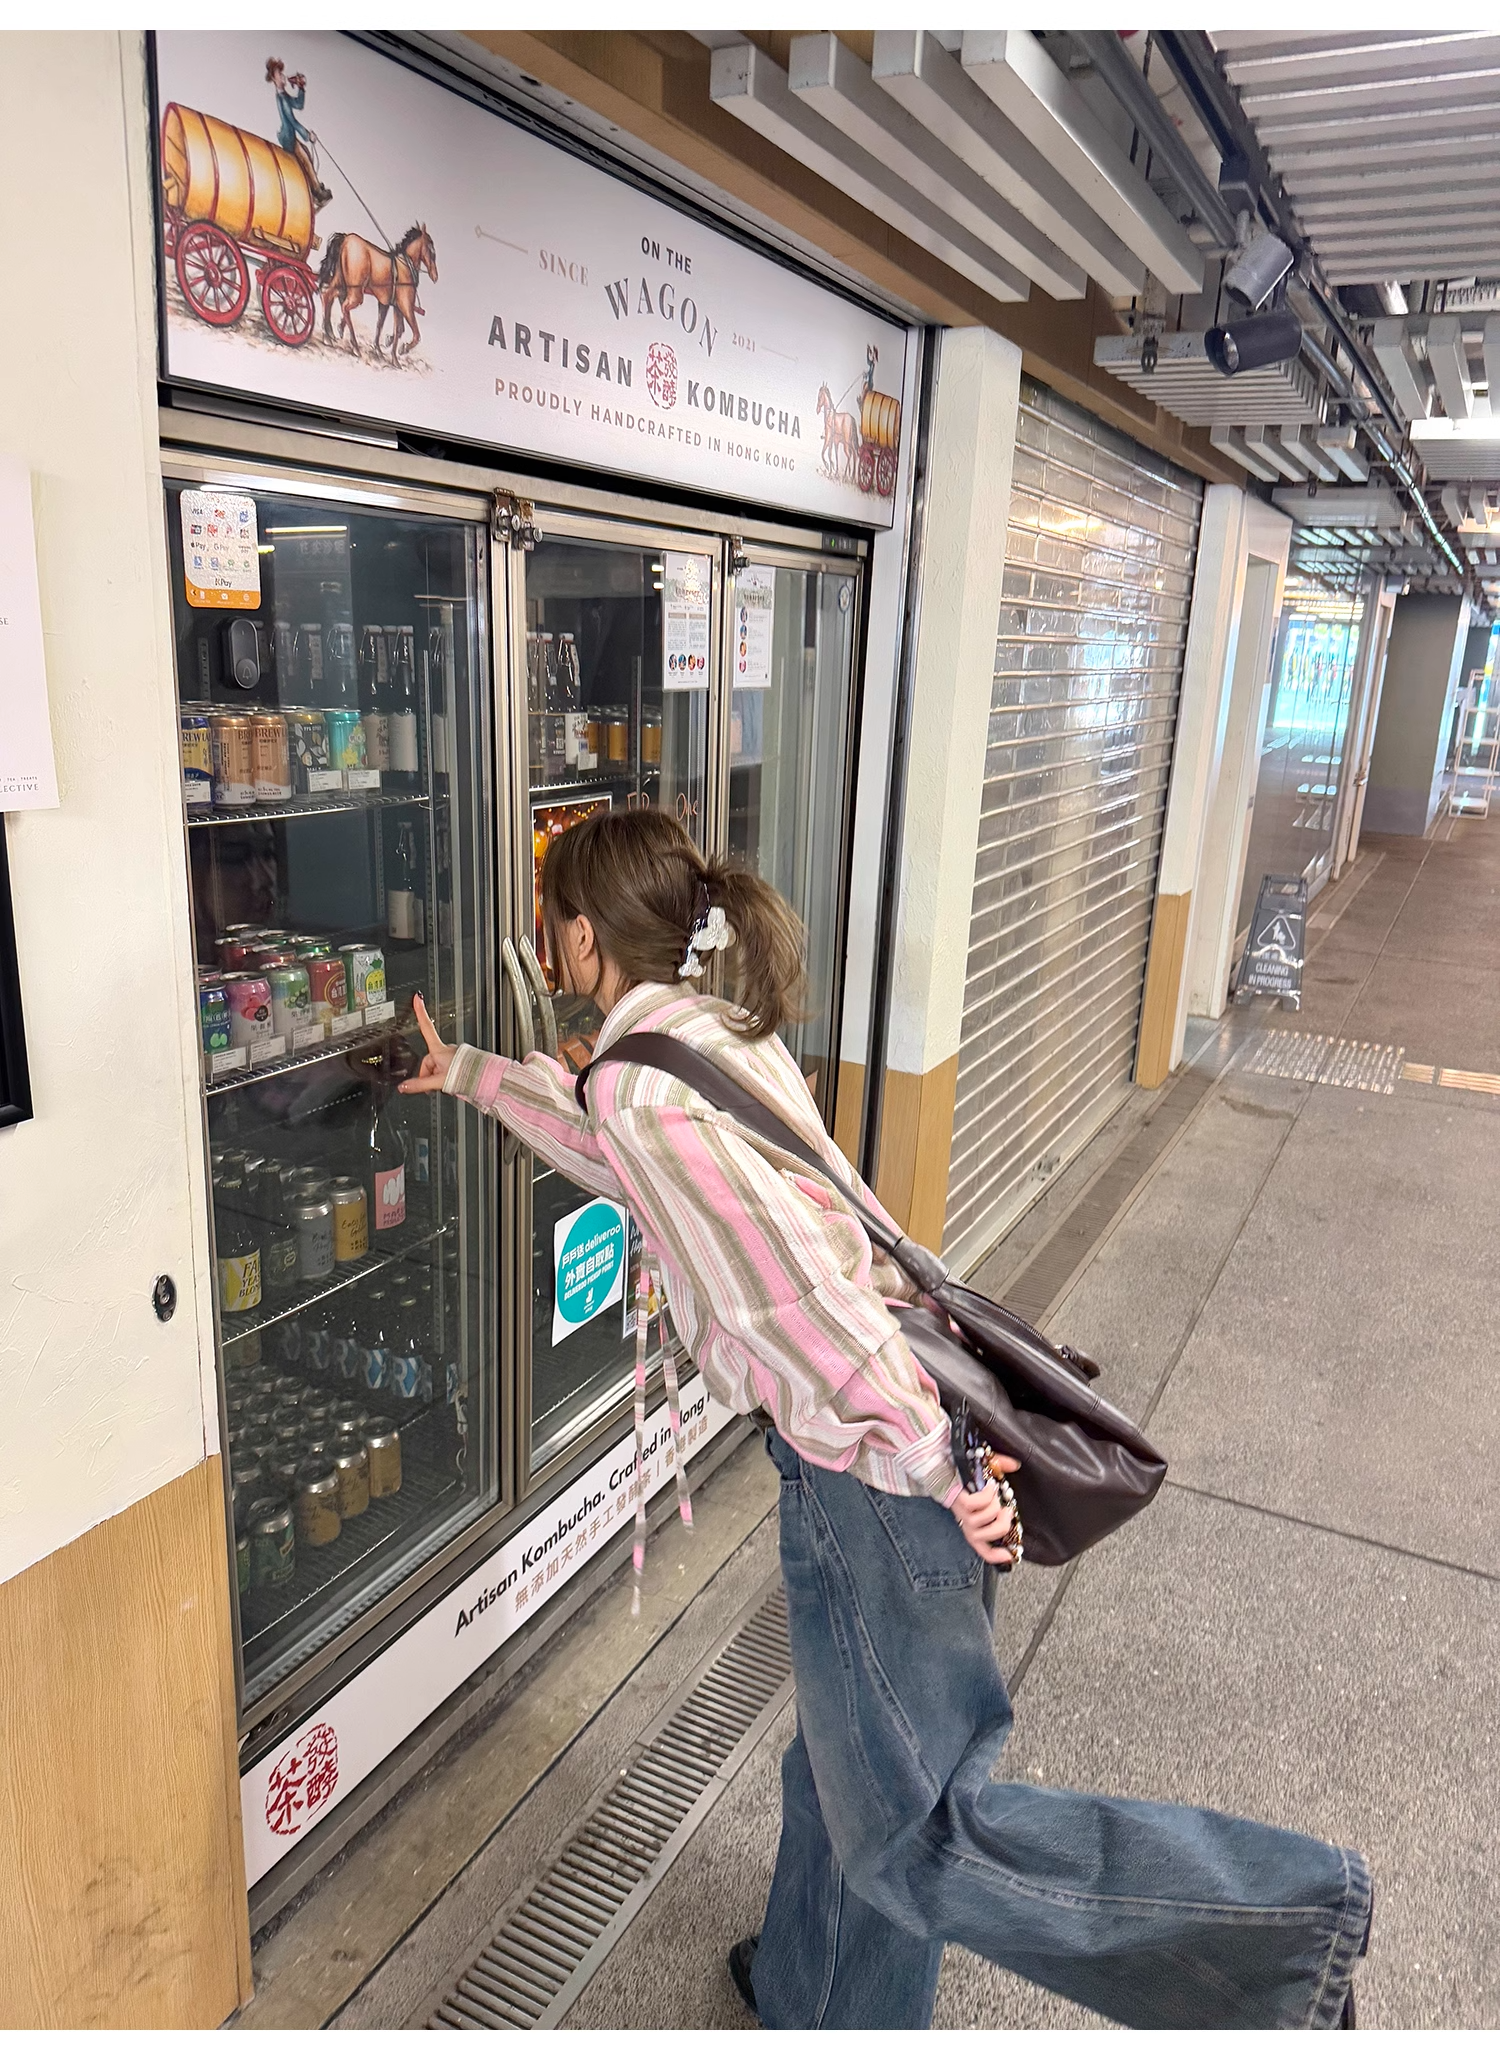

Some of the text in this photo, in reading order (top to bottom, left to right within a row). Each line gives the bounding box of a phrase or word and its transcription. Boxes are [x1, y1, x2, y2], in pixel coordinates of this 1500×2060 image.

[539, 249, 590, 287] SINCE
[641, 236, 692, 275] ON THE
[604, 277, 718, 357] WAGON
[488, 314, 633, 388] ARTISAN
[732, 332, 757, 353] 2021
[495, 378, 796, 472] PROUDLY HANDCRAFTED IN HONG KONG
[688, 379, 802, 440] KOMBUCHA
[1249, 974, 1292, 989] IN PROGRESS
[1256, 963, 1289, 976] CLEANING
[585, 1224, 621, 1252] deliveroo
[565, 1242, 615, 1290] 外賣自取點
[454, 1569, 518, 1638] Artisan
[521, 1492, 606, 1576] Kombucha.
[660, 1426, 672, 1446] in
